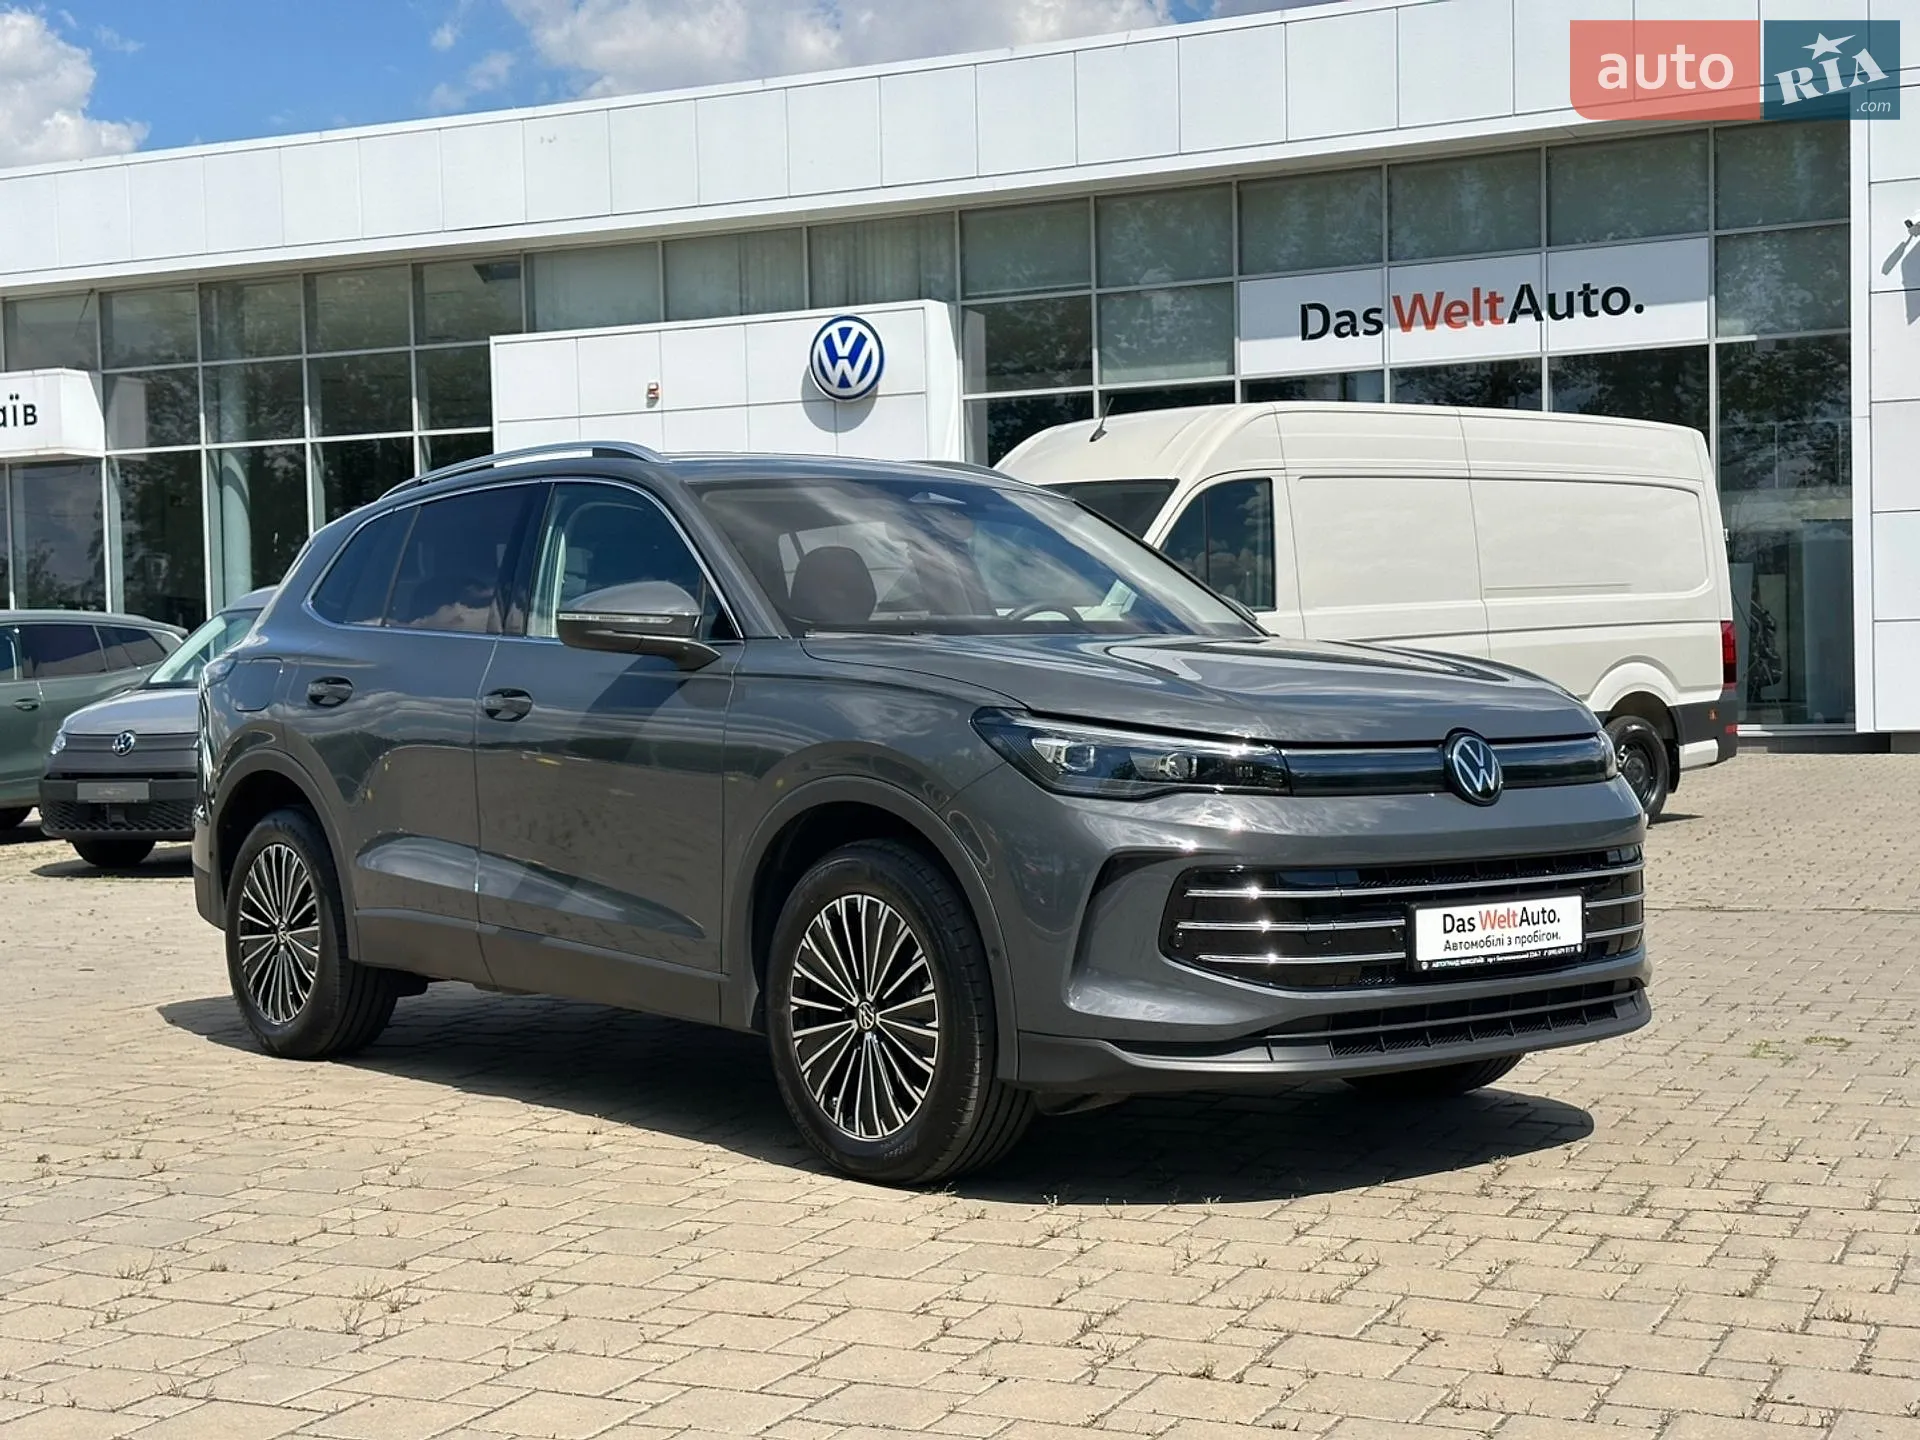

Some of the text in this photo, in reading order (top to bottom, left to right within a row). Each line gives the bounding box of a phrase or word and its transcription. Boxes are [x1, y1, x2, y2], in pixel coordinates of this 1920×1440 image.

[813, 320, 880, 396] VW
[1452, 736, 1502, 800] VW
[1443, 930, 1562, 952] Автомобілі з пробігом.
